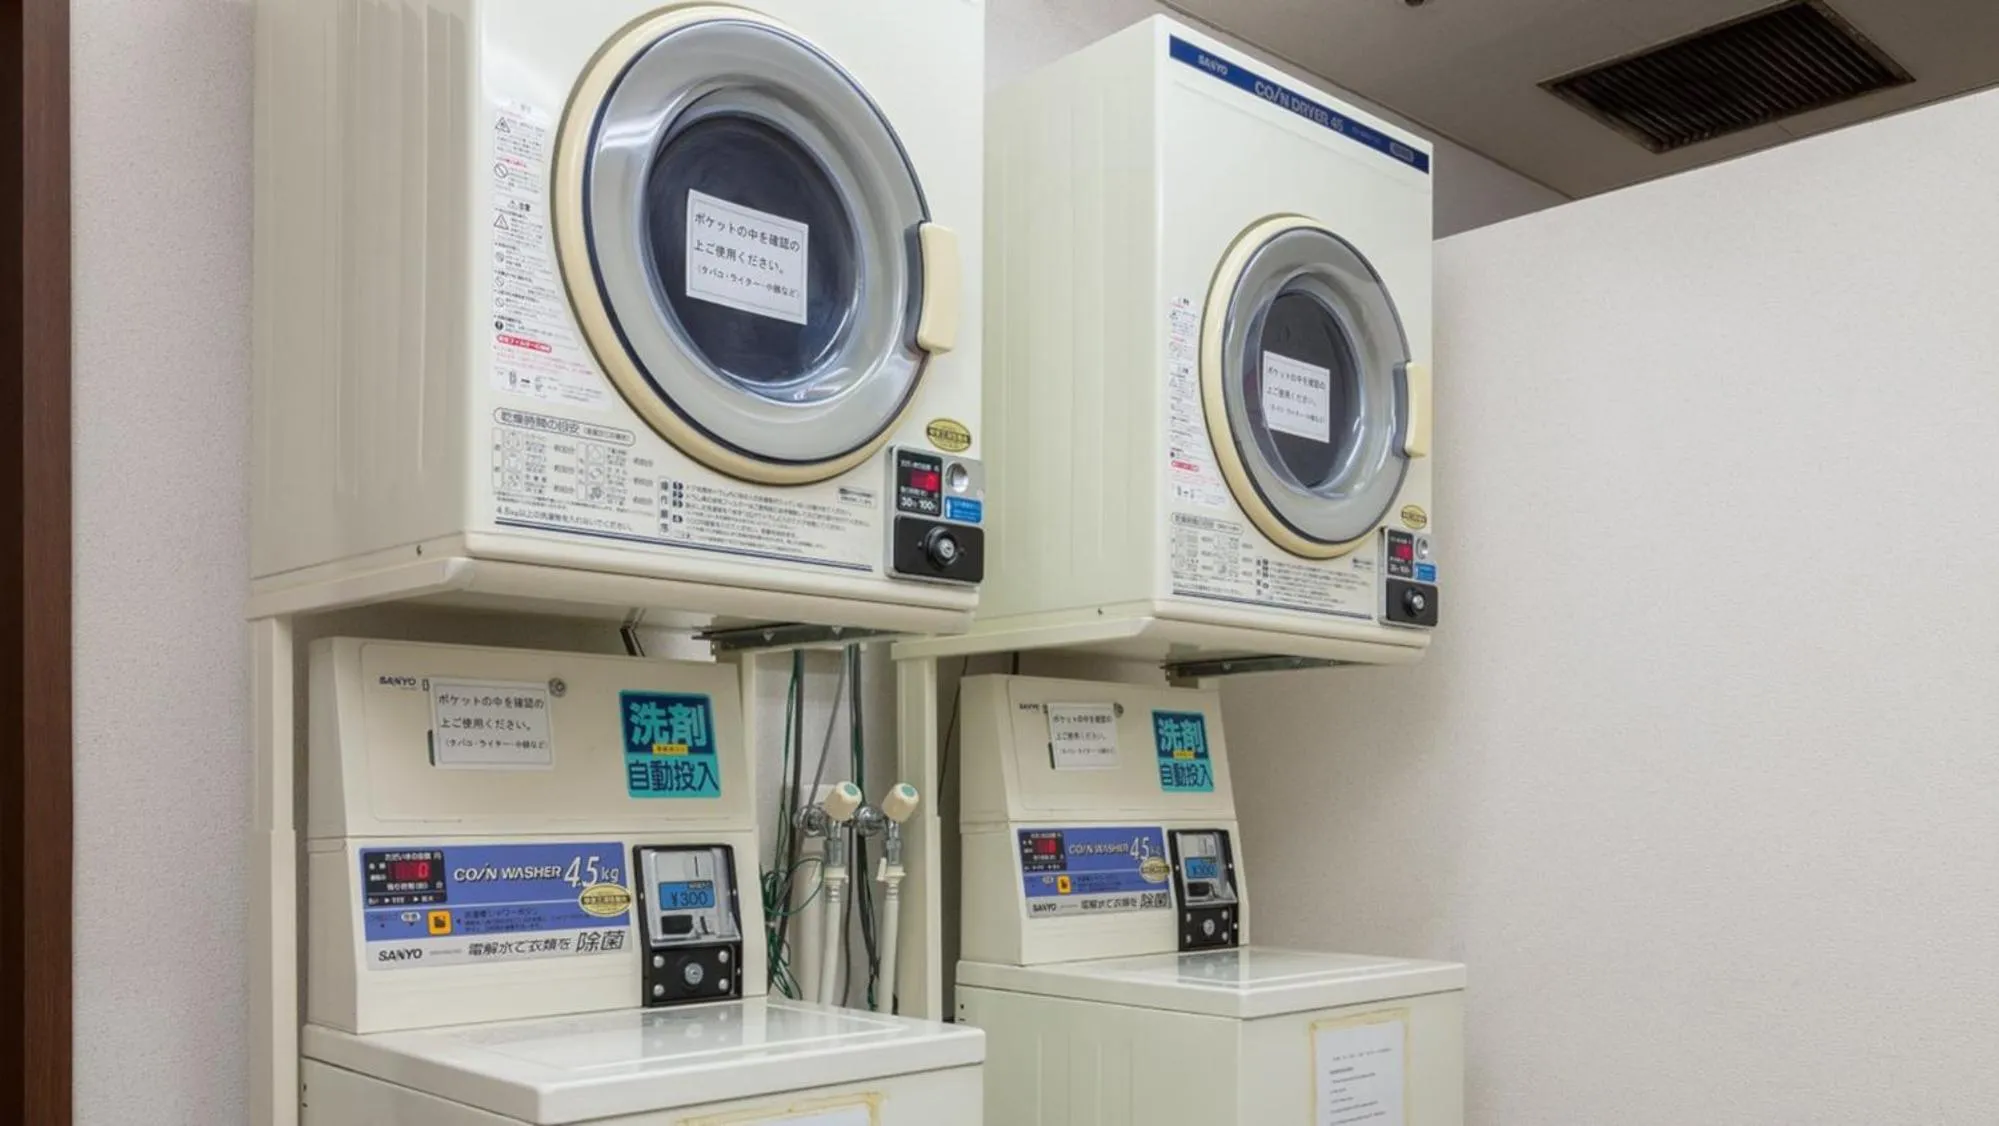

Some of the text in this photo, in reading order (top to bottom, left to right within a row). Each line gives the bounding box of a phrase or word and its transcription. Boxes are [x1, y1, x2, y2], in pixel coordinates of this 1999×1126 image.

[1291, 97, 1329, 127] DRYER
[1330, 117, 1344, 132] 45
[694, 212, 800, 253] ポケットの中を確認の
[694, 239, 784, 275] 上ご使用ください。
[439, 692, 545, 709] ポケットの中を確認の
[441, 717, 531, 732] 上ご使用ください。
[629, 701, 707, 748] 洗剤
[1158, 718, 1204, 753] 洗剤
[627, 760, 720, 792] 自動投入
[1160, 762, 1214, 788] 自動投入
[418, 862, 429, 879] 0
[502, 865, 563, 881] WASHER
[671, 890, 709, 907] ¥300
[1032, 903, 1057, 912] SANYO
[378, 948, 422, 962] SANYO
[468, 930, 626, 956] 電解水で衣類を 除菌
